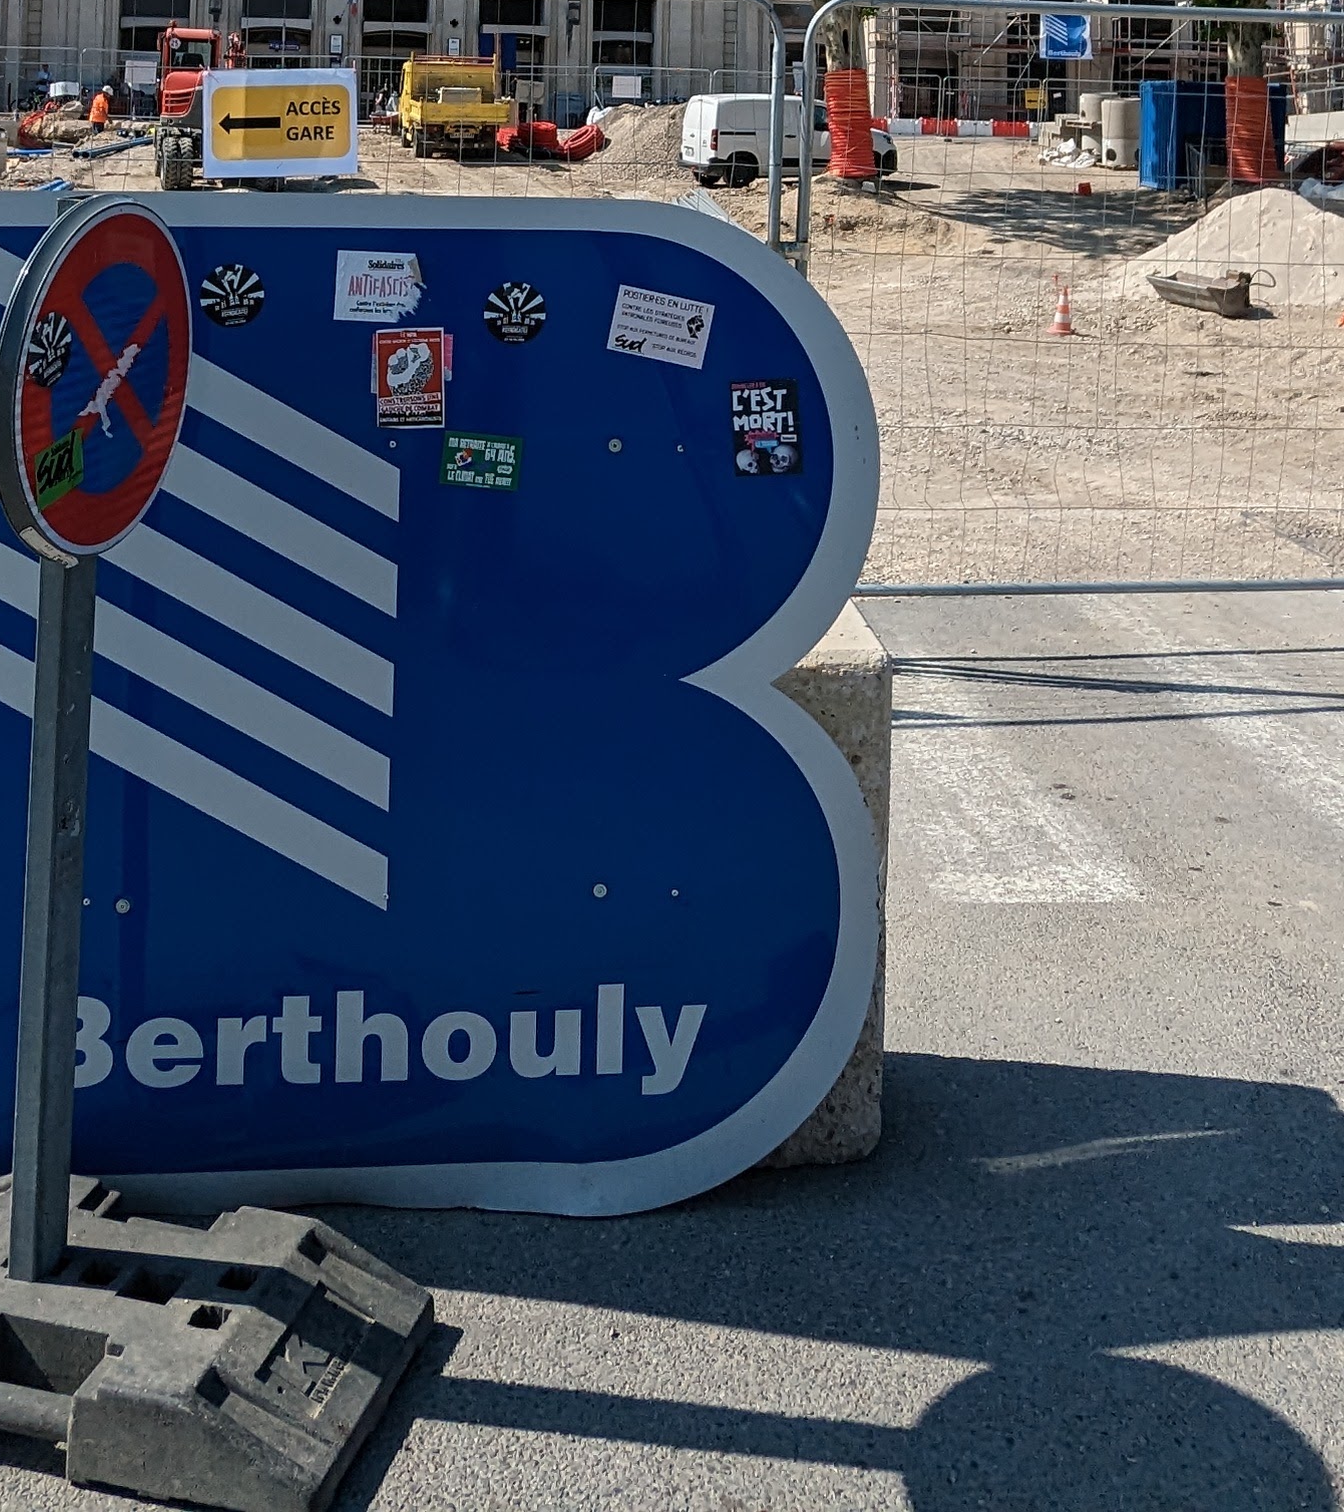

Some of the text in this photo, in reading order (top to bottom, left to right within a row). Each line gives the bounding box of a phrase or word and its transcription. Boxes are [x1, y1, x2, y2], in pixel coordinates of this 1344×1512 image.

[285, 96, 341, 116] ACCÈS
[285, 125, 335, 141] GARE
[367, 259, 405, 270] Solidaires
[668, 300, 678, 309] EN
[680, 303, 704, 314] LUTTE
[731, 386, 788, 412] C'EST
[732, 411, 795, 434] MORT!
[485, 449, 496, 461] 64
